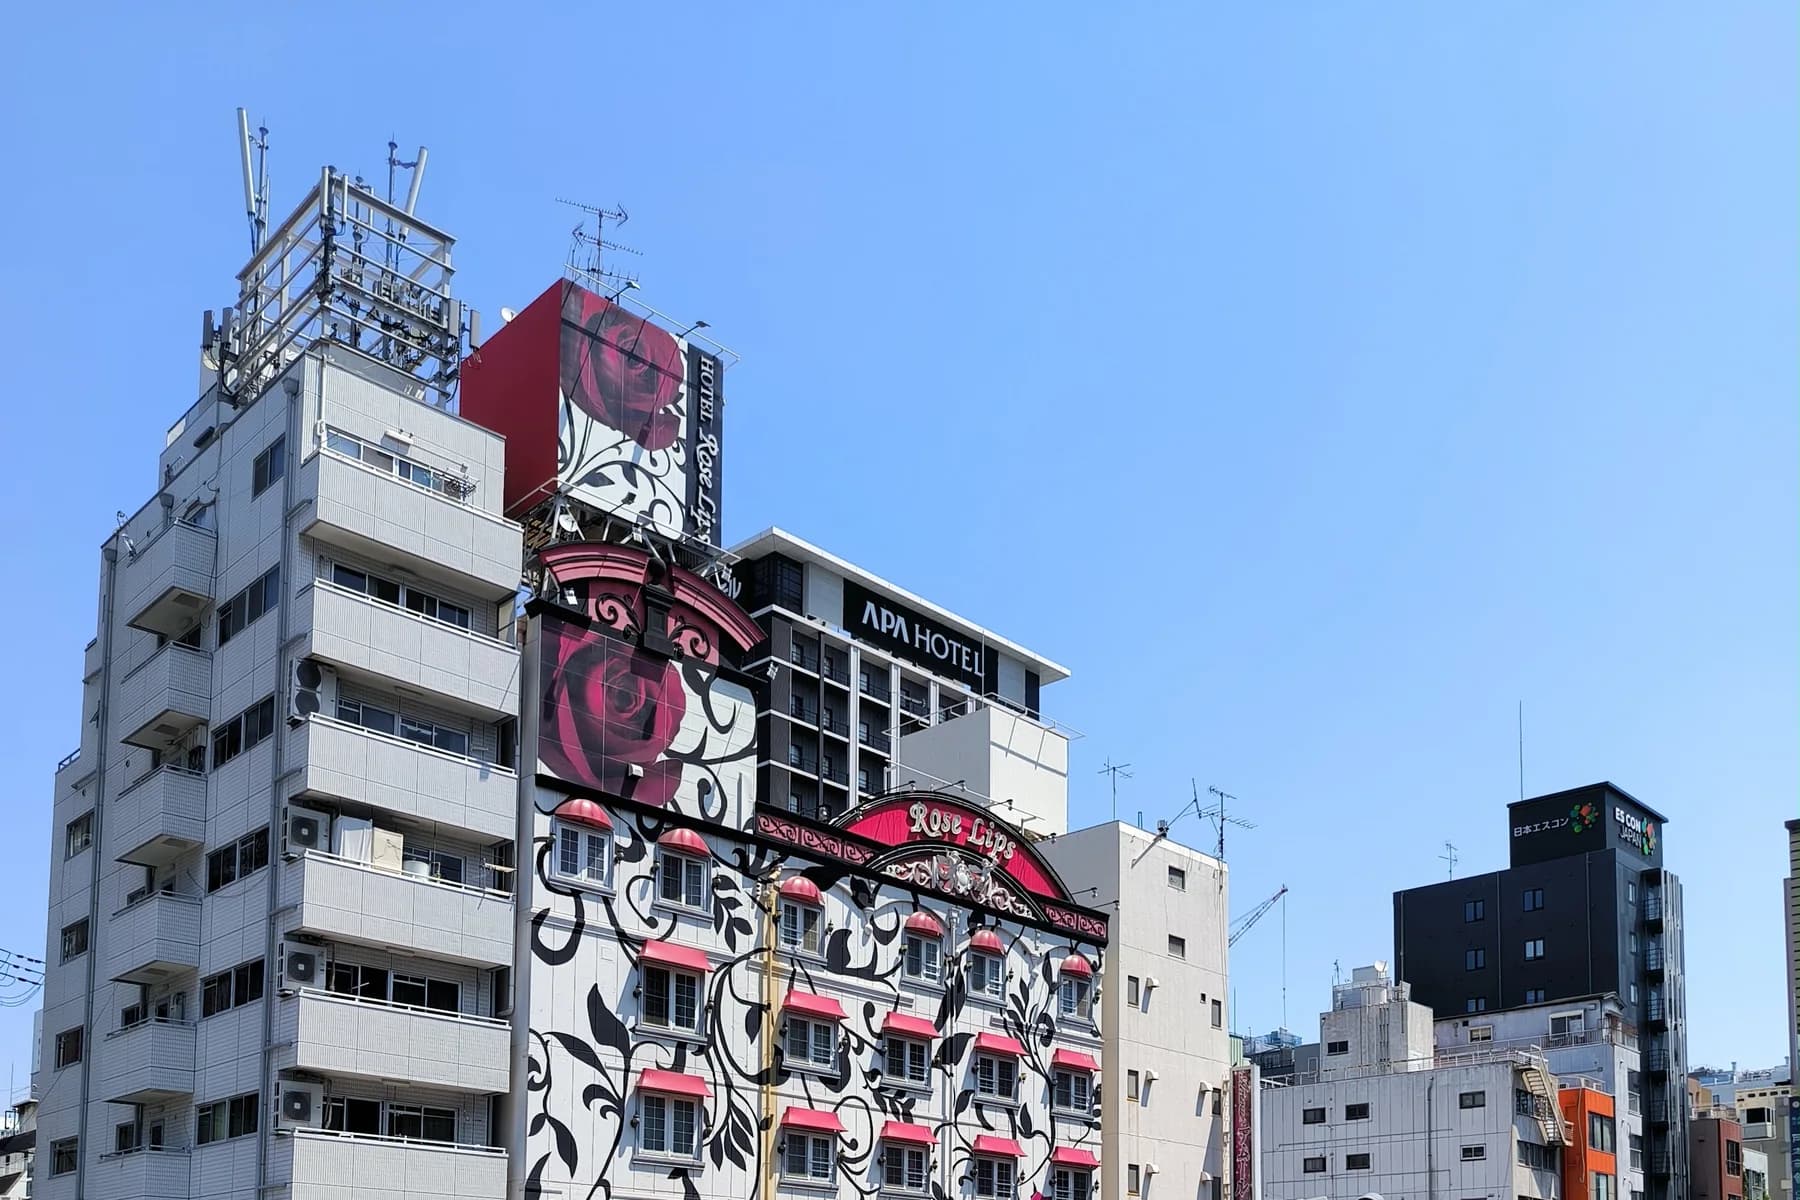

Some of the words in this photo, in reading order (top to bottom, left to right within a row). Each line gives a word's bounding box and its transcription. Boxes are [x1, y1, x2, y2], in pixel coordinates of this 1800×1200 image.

[700, 355, 715, 427] HOTEL
[696, 427, 720, 490] Rose
[690, 485, 717, 549] Lips
[861, 600, 911, 645] APA
[914, 623, 986, 677] HOTEL
[909, 801, 963, 837] Rose
[967, 818, 1017, 860] Lips
[1513, 817, 1569, 838] 日本エスコン
[1615, 806, 1626, 824] ES
[1625, 813, 1642, 833] CON
[1618, 825, 1642, 849] JAPAN
